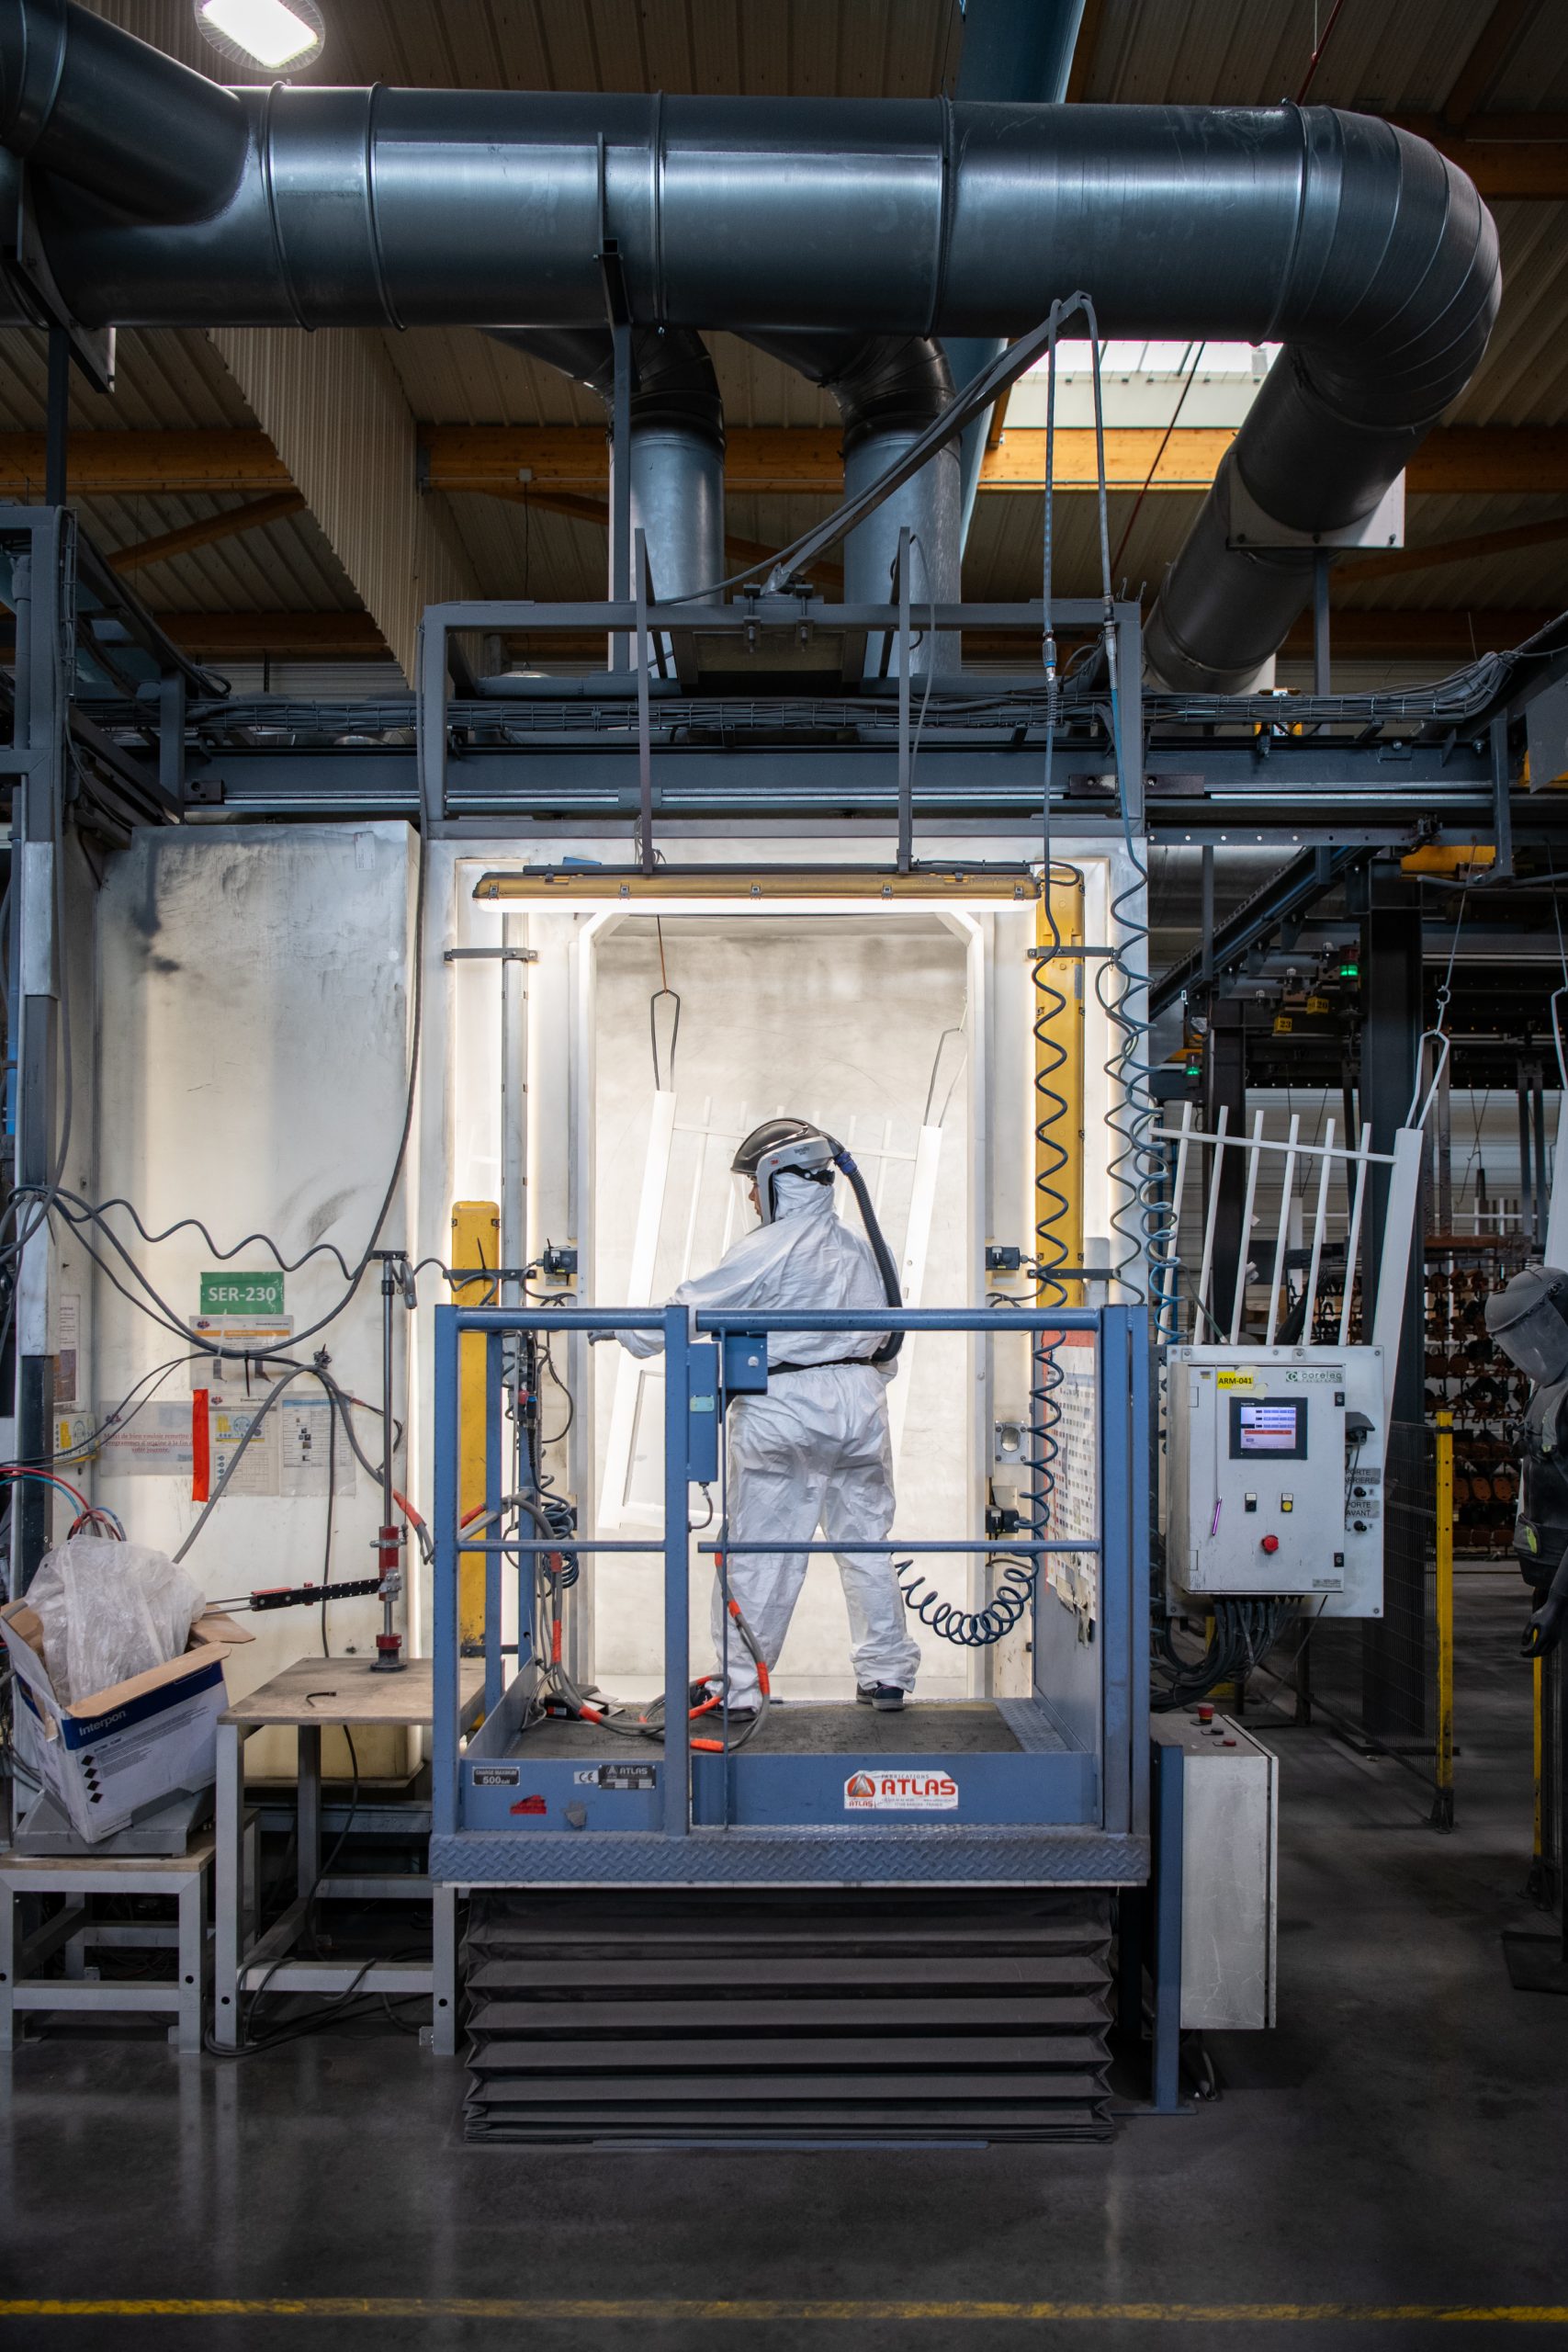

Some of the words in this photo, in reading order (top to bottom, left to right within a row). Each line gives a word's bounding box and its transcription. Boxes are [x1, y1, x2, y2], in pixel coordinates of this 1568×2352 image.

[209, 1287, 276, 1302] SER-230
[1303, 1371, 1342, 1379] corelec
[78, 1710, 127, 1737] Interpon
[580, 1771, 594, 1782] CE
[619, 1767, 649, 1775] ATLAS
[482, 1776, 502, 1784] 500
[882, 1779, 955, 1795] ATLAS
